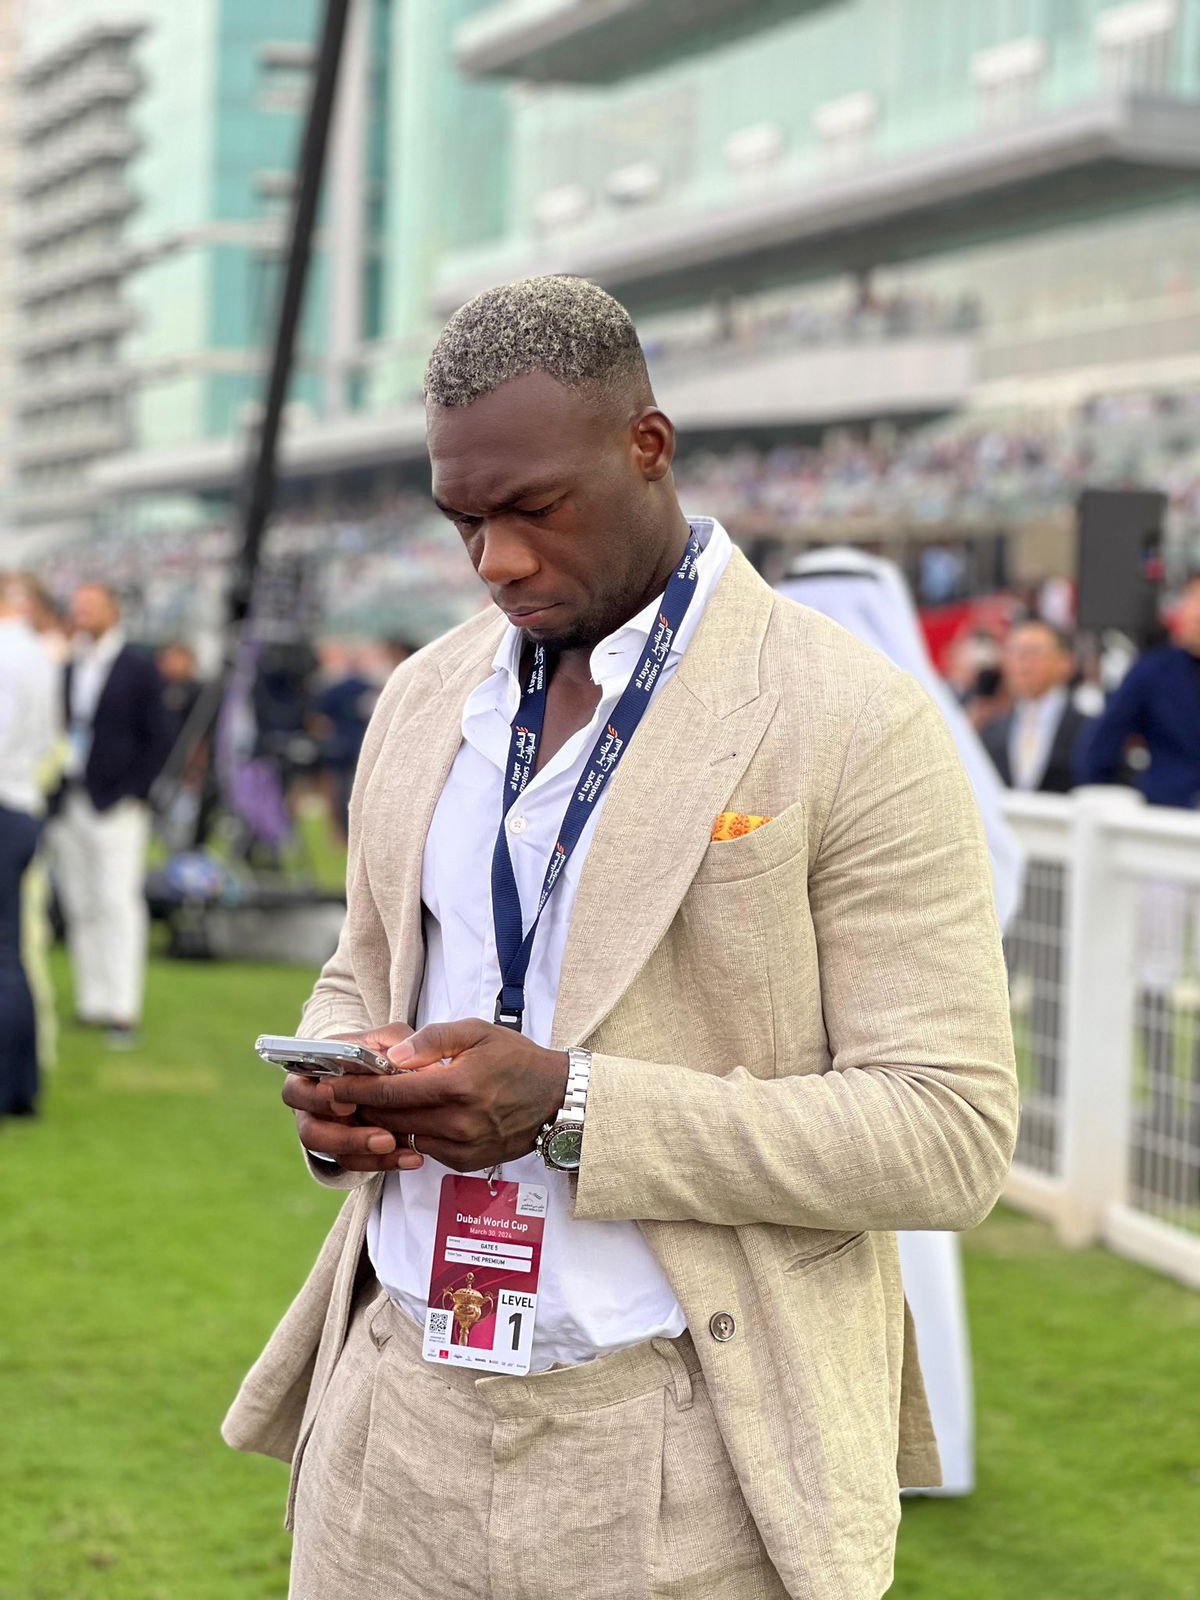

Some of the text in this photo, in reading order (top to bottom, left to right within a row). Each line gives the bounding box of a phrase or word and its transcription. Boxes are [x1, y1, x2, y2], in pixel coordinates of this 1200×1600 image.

[635, 657, 651, 689] al tayer
[644, 663, 660, 692] motors
[510, 762, 521, 791] al tayer
[578, 770, 596, 802] al tayer
[586, 773, 605, 803] motors
[456, 1213, 528, 1232] Dubai World Cup
[470, 1227, 488, 1236] March
[498, 1231, 512, 1239] 2024
[480, 1243, 494, 1251] GATE
[481, 1257, 506, 1265] PREMIUM
[501, 1294, 534, 1309] LEVEL
[509, 1312, 522, 1351] 1
